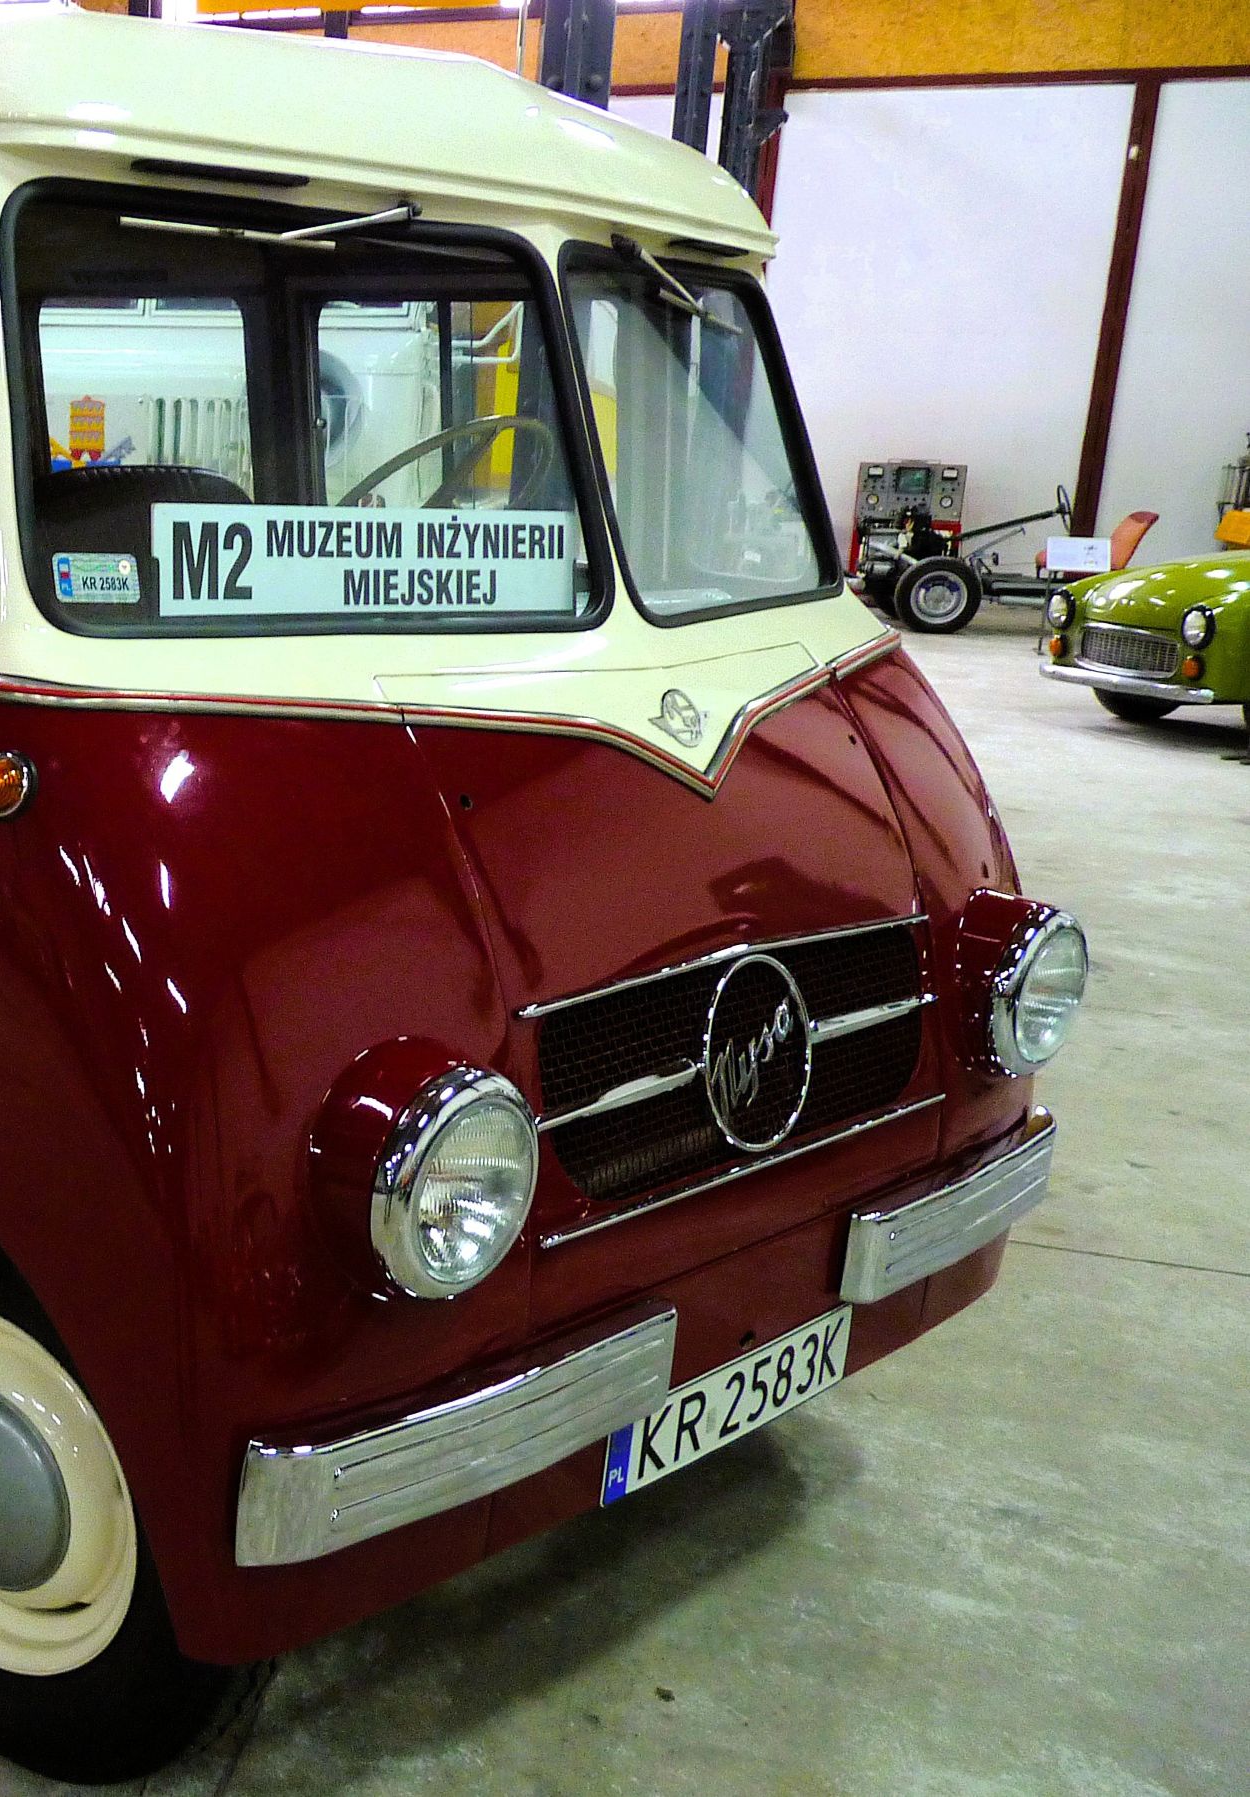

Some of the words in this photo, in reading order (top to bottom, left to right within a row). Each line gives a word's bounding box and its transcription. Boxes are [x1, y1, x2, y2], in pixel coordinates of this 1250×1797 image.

[266, 520, 402, 558] MUZEUM
[417, 515, 565, 559] INŻYNIERII
[173, 521, 253, 600] M2
[81, 576, 97, 590] KR
[100, 576, 129, 591] 2583K
[343, 569, 497, 606] MIEJSKIEJ
[711, 997, 793, 1126] Nysa
[638, 1391, 707, 1479] KR
[719, 1317, 844, 1438] 2583K
[608, 1467, 624, 1488] PL
